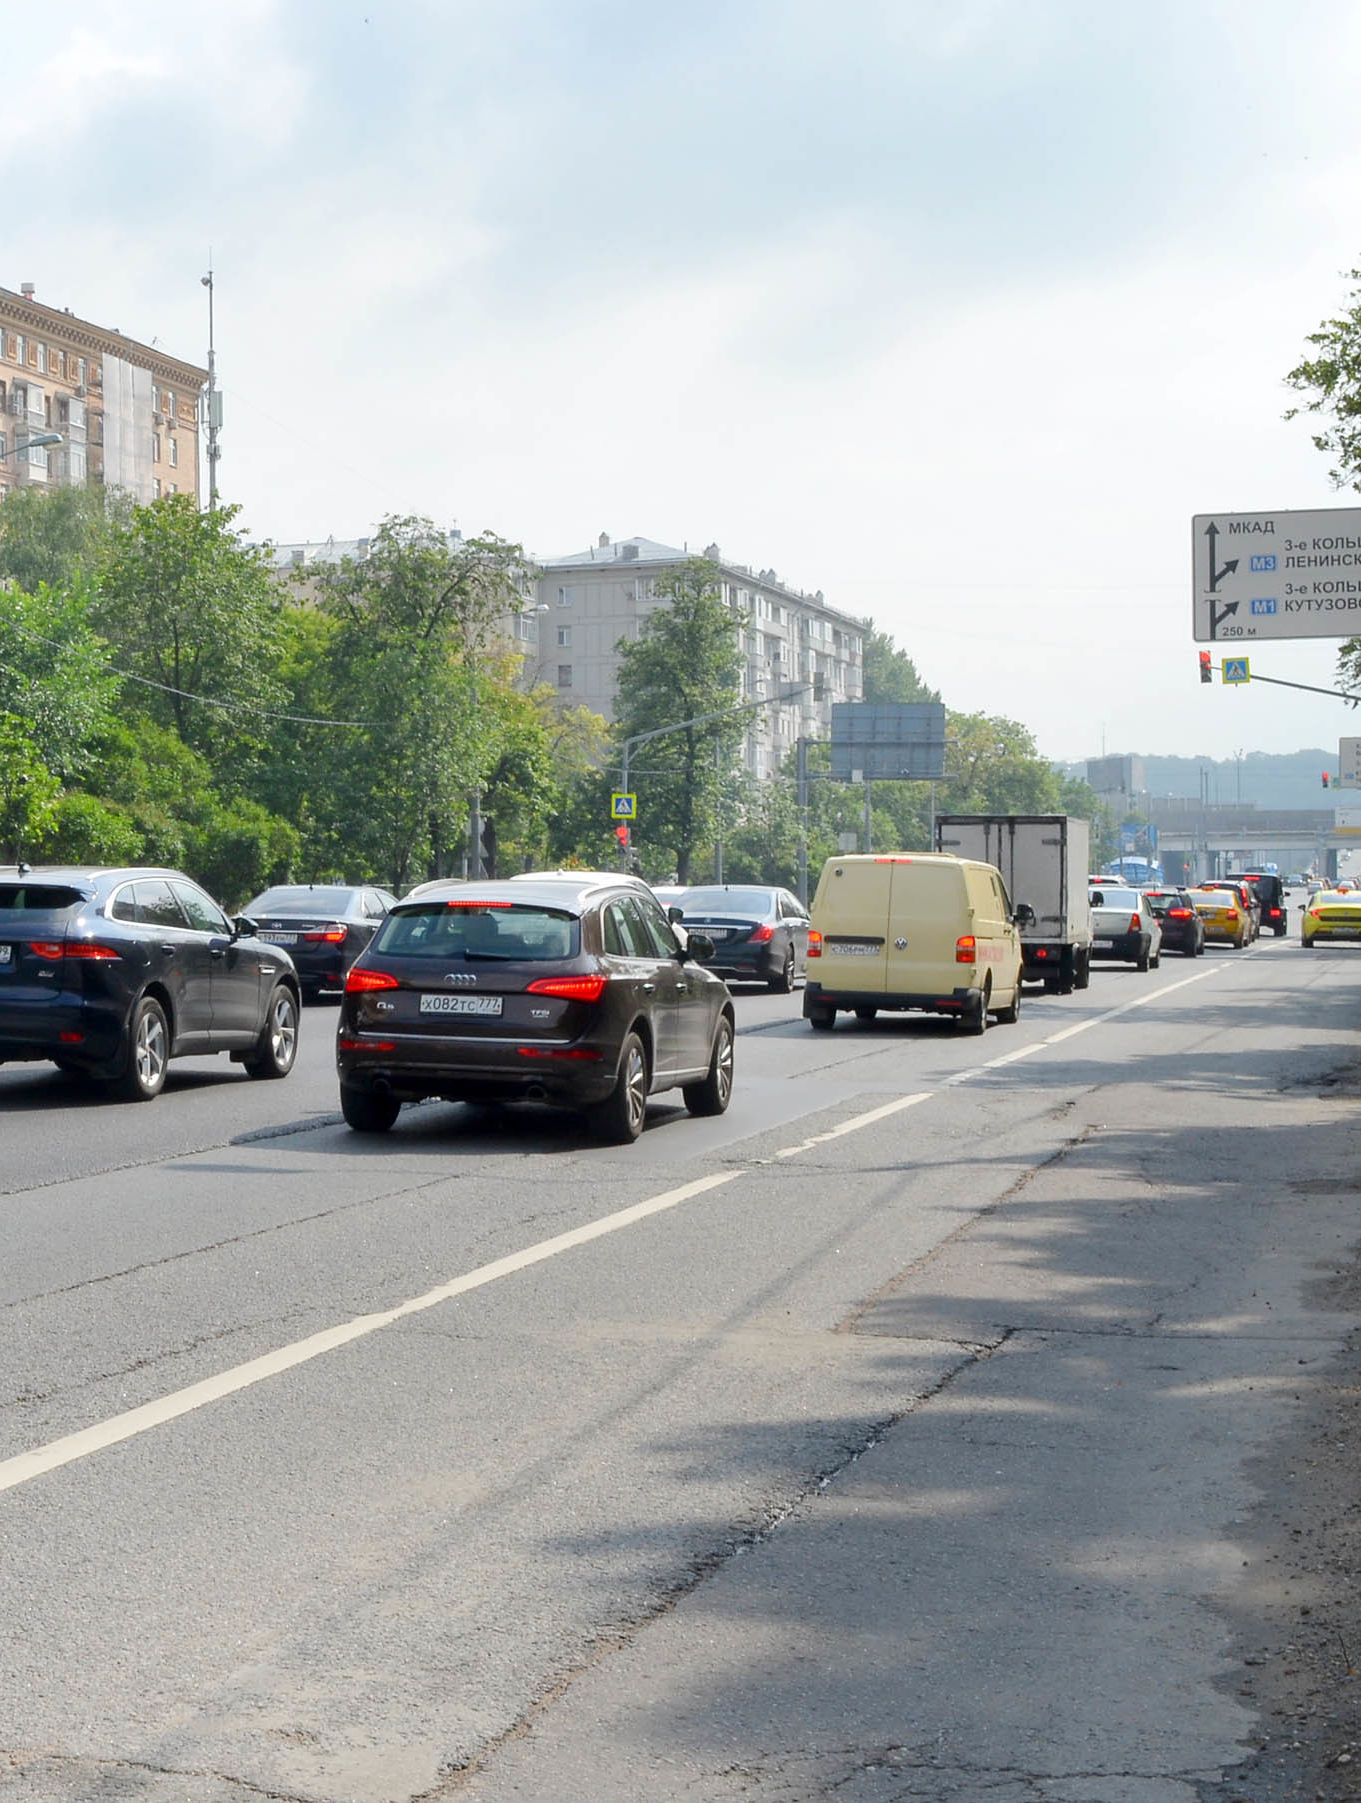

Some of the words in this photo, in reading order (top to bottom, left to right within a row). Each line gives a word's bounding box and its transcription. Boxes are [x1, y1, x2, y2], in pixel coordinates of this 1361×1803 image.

[1229, 521, 1275, 535] МКАД
[1285, 539, 1307, 551] 3-е
[1252, 557, 1275, 570] М3
[1285, 583, 1307, 595] 3-е
[1253, 600, 1276, 613] М1
[1285, 598, 1361, 612] КУТУЗОВ
[1222, 627, 1243, 636] 250
